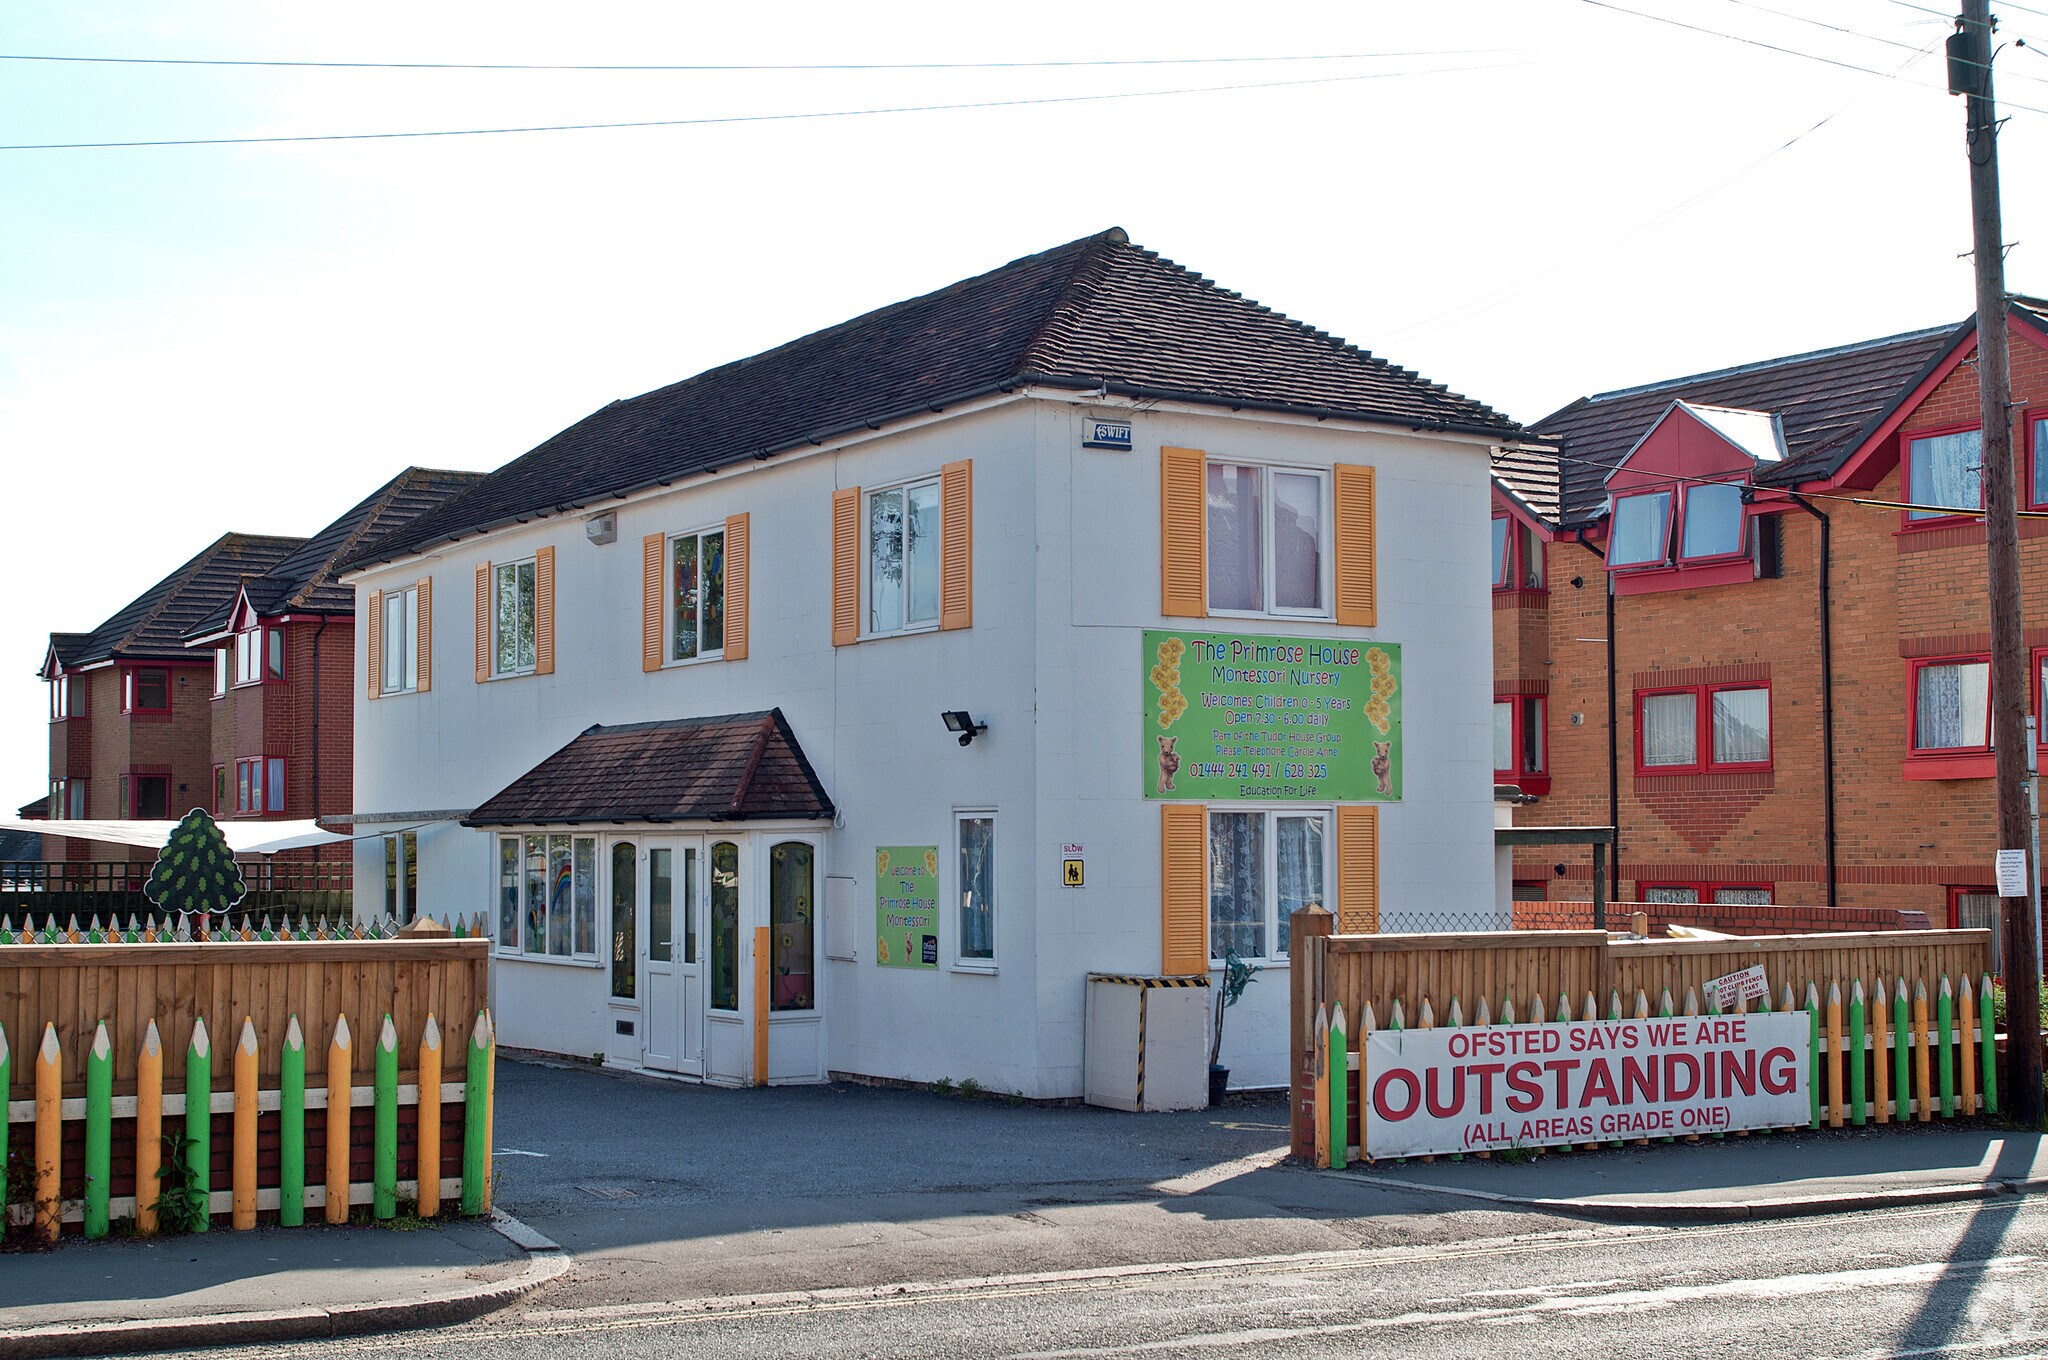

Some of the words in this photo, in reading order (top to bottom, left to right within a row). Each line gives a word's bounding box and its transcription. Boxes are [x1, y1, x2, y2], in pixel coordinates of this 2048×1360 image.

[1101, 426, 1130, 438] SWIFT
[1192, 640, 1226, 663] The
[1230, 640, 1304, 663] Primrose
[1309, 644, 1359, 666] House
[1212, 665, 1286, 684] Montessori
[1290, 669, 1340, 686] Nursery
[1201, 692, 1252, 708] Welcomes
[1255, 695, 1298, 709] Children
[1316, 699, 1321, 709] 5
[1324, 697, 1351, 710] Years
[1225, 711, 1252, 725] Open
[1255, 713, 1274, 723] 7.30
[1284, 713, 1304, 724] 6.00
[1307, 713, 1328, 725] daily
[1212, 730, 1231, 741] Part
[1233, 731, 1242, 741] of
[1245, 732, 1259, 741] the
[1261, 731, 1286, 742] Tudor
[1288, 732, 1314, 742] House
[1316, 733, 1341, 743] Group
[1215, 745, 1241, 757] Please
[1243, 746, 1285, 757] Telephone
[1288, 746, 1314, 757] Carole
[1316, 748, 1337, 757] Anne
[1190, 763, 1224, 778] 01444
[1228, 763, 1247, 778] 241
[1252, 763, 1271, 778] 491
[1284, 763, 1304, 778] 628
[1308, 764, 1326, 778] 325
[1240, 785, 1281, 797] Education
[1284, 786, 1297, 796] For
[1300, 785, 1316, 796] Life
[918, 866, 924, 876] to
[900, 881, 914, 894] The
[880, 896, 910, 910] Primrose
[912, 896, 936, 911] House
[886, 914, 930, 928] Montessori
[1718, 970, 1750, 985] CAUTION
[1746, 974, 1763, 985] FENCE
[1448, 1029, 1561, 1059] OFSTED
[1569, 1025, 1639, 1052] SAYS
[1646, 1023, 1688, 1048] WE
[1695, 1020, 1747, 1045] ARE
[1373, 1046, 1797, 1122] OUTSTANDING
[1463, 1122, 1512, 1149] (ALL
[1519, 1115, 1594, 1140] AREAS
[1600, 1110, 1674, 1134] GRADE
[1680, 1106, 1731, 1130] ONE)
